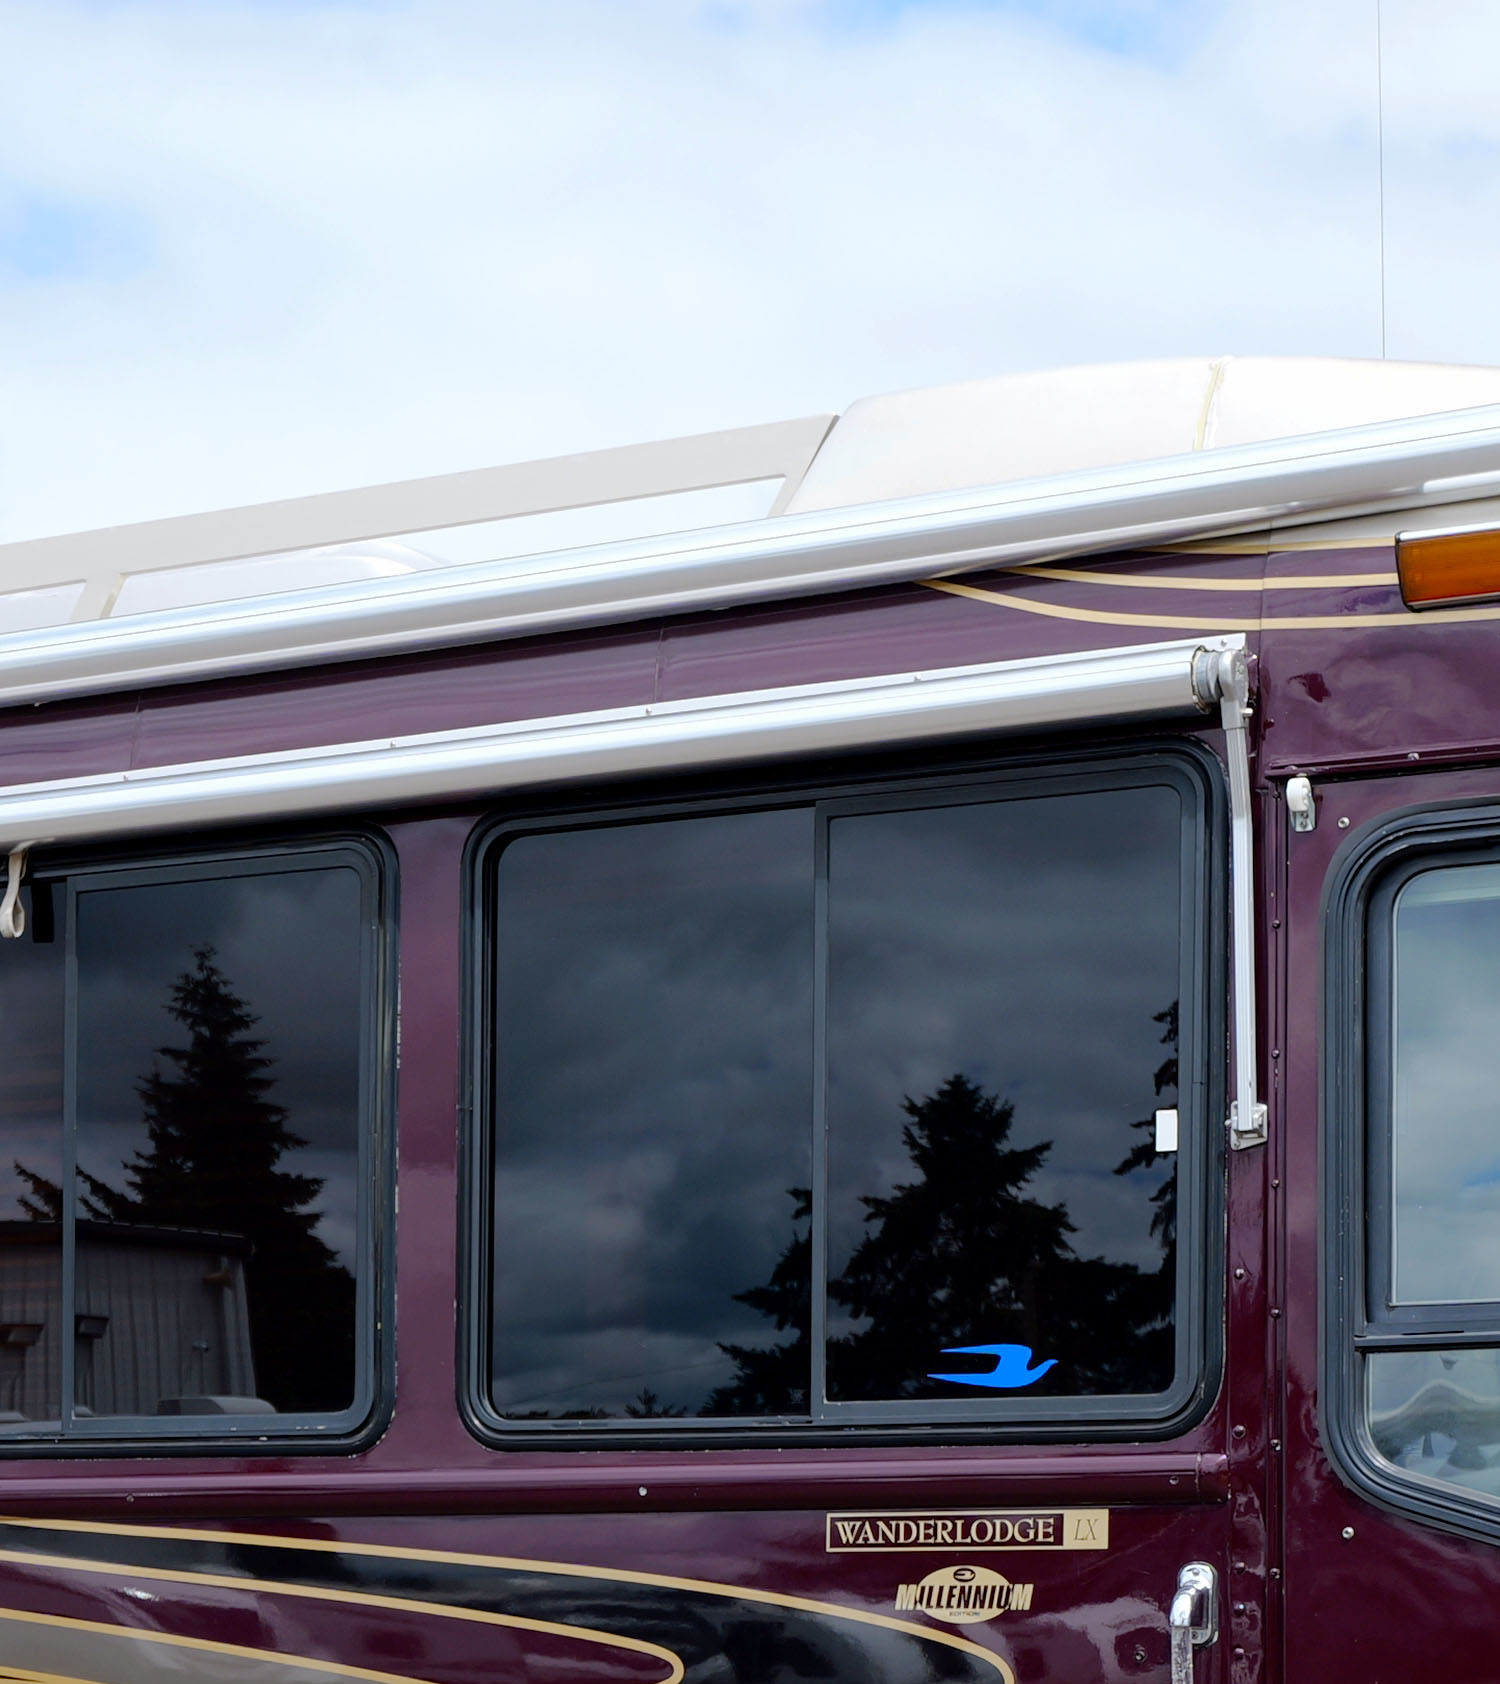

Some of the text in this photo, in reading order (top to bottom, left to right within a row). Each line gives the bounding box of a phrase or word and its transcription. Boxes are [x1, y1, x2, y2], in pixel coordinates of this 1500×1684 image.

[834, 1517, 1099, 1545] WANDERLODGE LX
[894, 1583, 1034, 1611] MILLENNIUM
